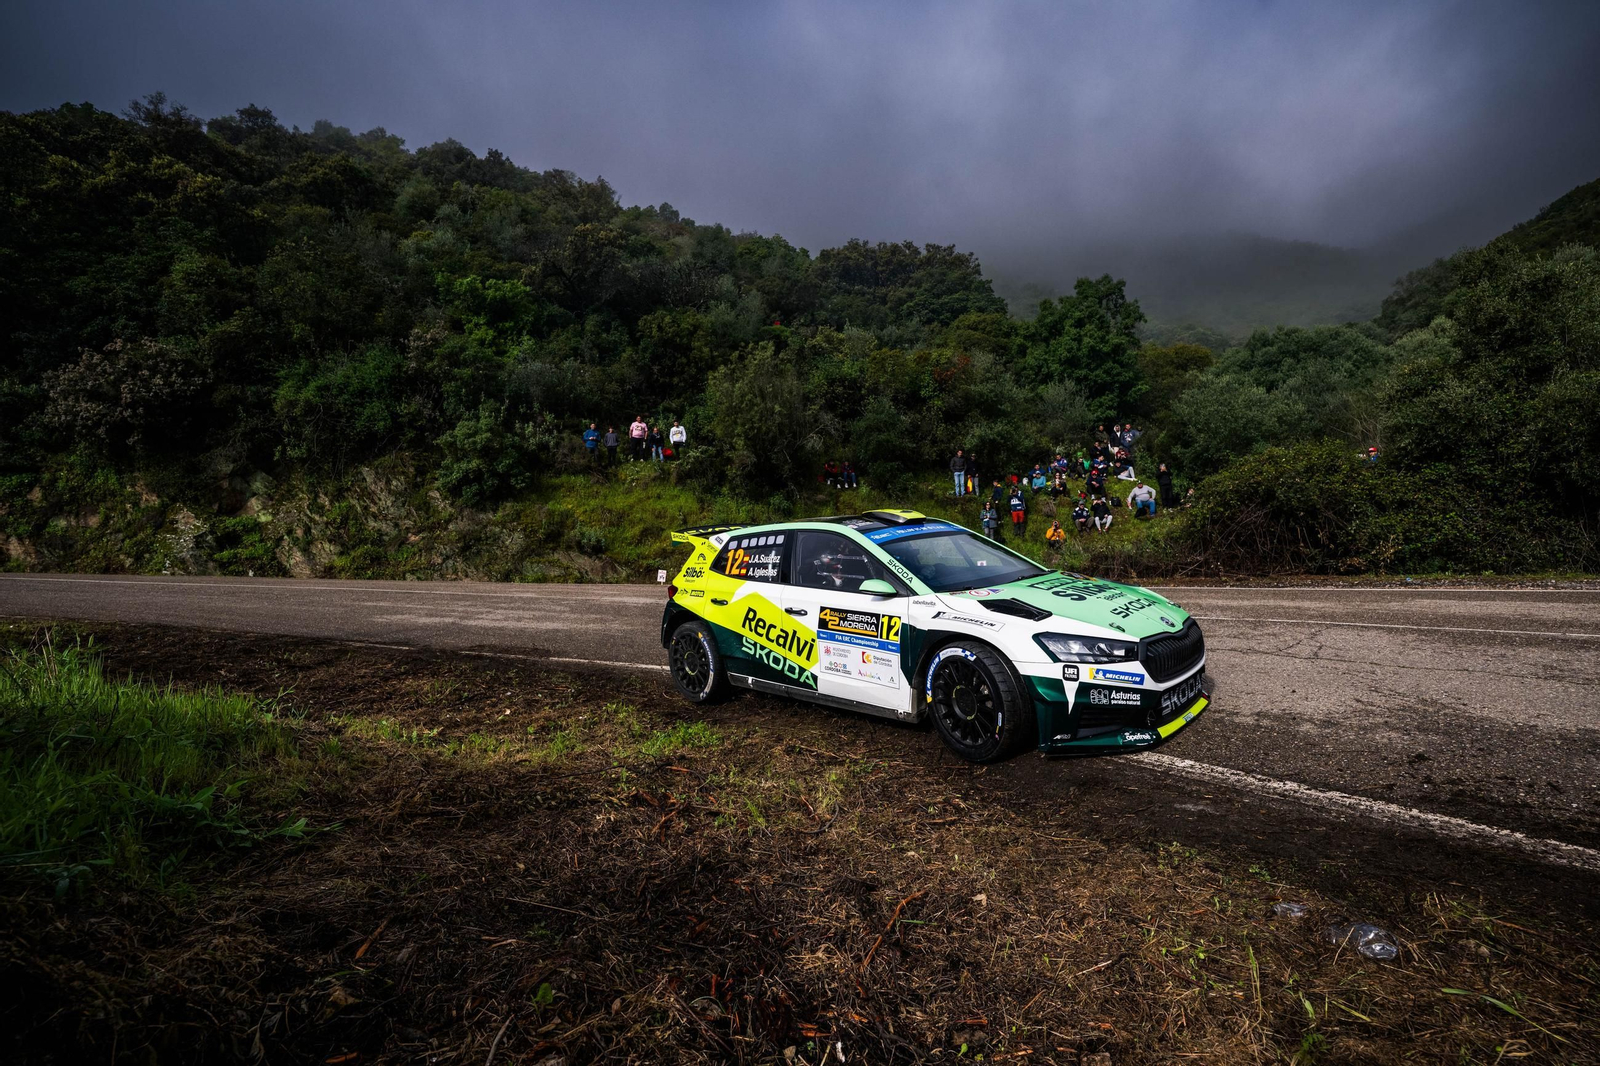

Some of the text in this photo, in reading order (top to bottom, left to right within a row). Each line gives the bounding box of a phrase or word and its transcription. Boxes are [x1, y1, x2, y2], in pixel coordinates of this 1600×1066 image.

[725, 549, 745, 575] 12
[887, 558, 914, 584] SKODA
[839, 620, 877, 632] MORENA
[847, 613, 878, 624] SIERRA
[952, 616, 997, 627] MICHELIN
[741, 606, 816, 662] Recalvi
[881, 615, 901, 642] 12
[850, 637, 879, 648] Championship
[741, 636, 817, 690] SKODA
[926, 655, 940, 690] MICHELIN
[1064, 667, 1078, 675] UFI
[1105, 673, 1141, 682] MICHELIN
[1110, 690, 1141, 700] Asturias
[1161, 674, 1202, 716] SKODA
